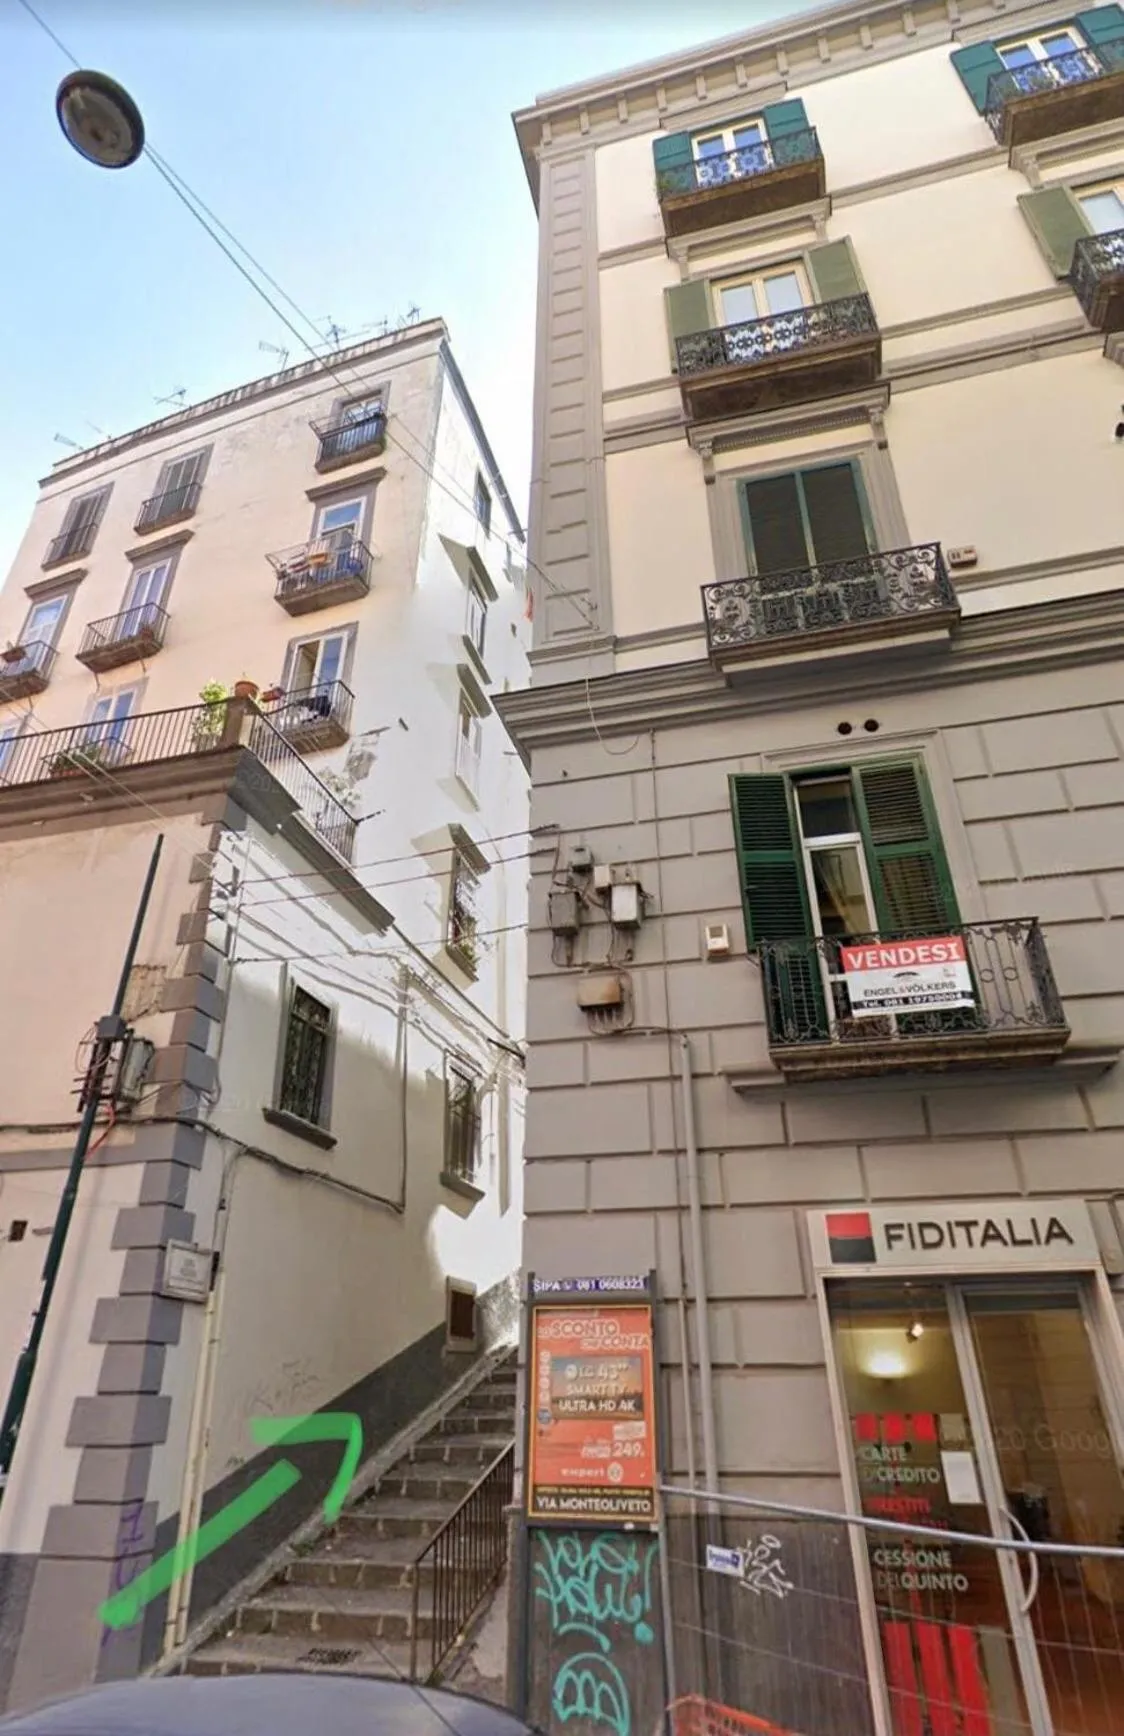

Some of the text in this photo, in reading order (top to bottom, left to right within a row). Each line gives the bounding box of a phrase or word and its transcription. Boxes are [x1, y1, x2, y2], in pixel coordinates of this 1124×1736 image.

[847, 942, 961, 969] VENDESI
[884, 1217, 1075, 1250] FIDITALIA
[551, 1320, 619, 1338] SCONTO
[567, 1384, 607, 1396] SMART
[559, 1399, 596, 1412] ULTRA
[600, 1400, 617, 1412] HD
[862, 1446, 908, 1461] CARTE
[877, 1467, 941, 1484] CREDITO
[536, 1496, 651, 1512] VIA MONTEOLIVETO
[873, 1548, 953, 1569] CESSIONE
[900, 1571, 970, 1592] QUINTO
